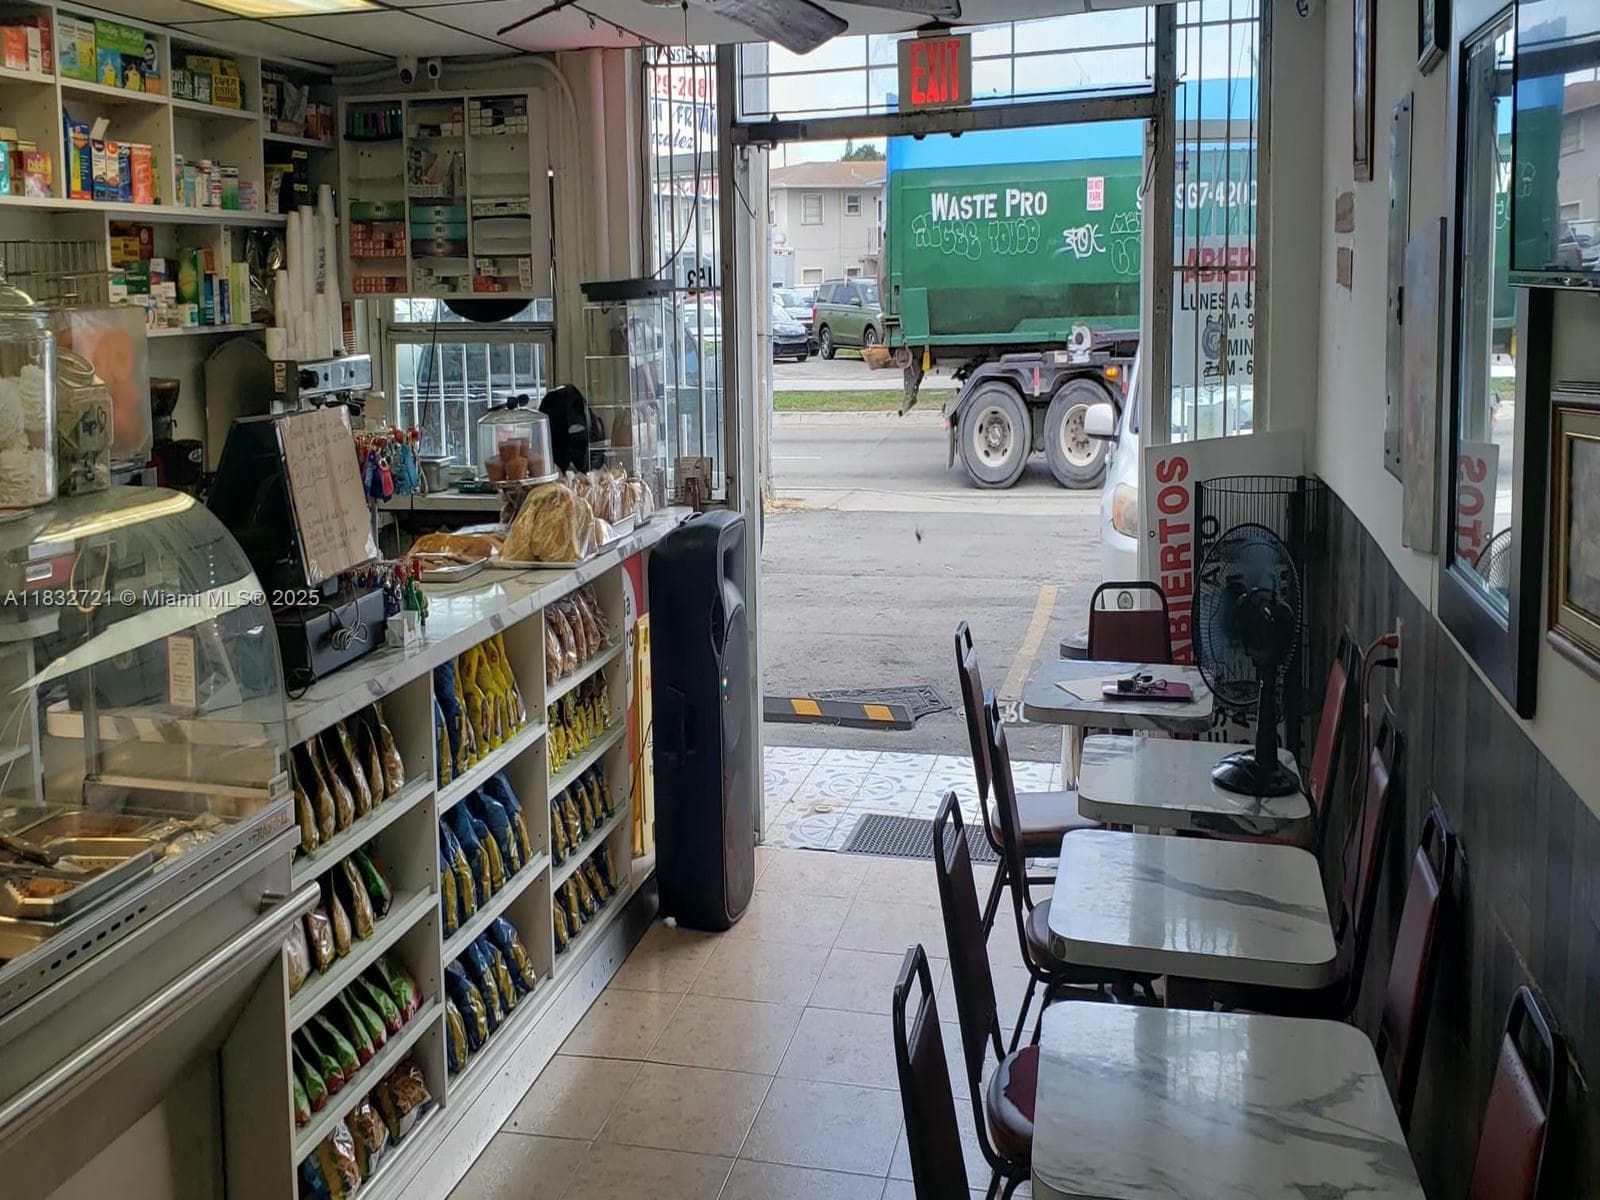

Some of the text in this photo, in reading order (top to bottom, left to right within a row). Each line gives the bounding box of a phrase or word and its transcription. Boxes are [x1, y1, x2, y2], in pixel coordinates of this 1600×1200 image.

[911, 39, 961, 105] EXIT
[1180, 292, 1226, 311] LUNES
[1230, 292, 1240, 310] A
[1155, 455, 1194, 667] ABIERTOS
